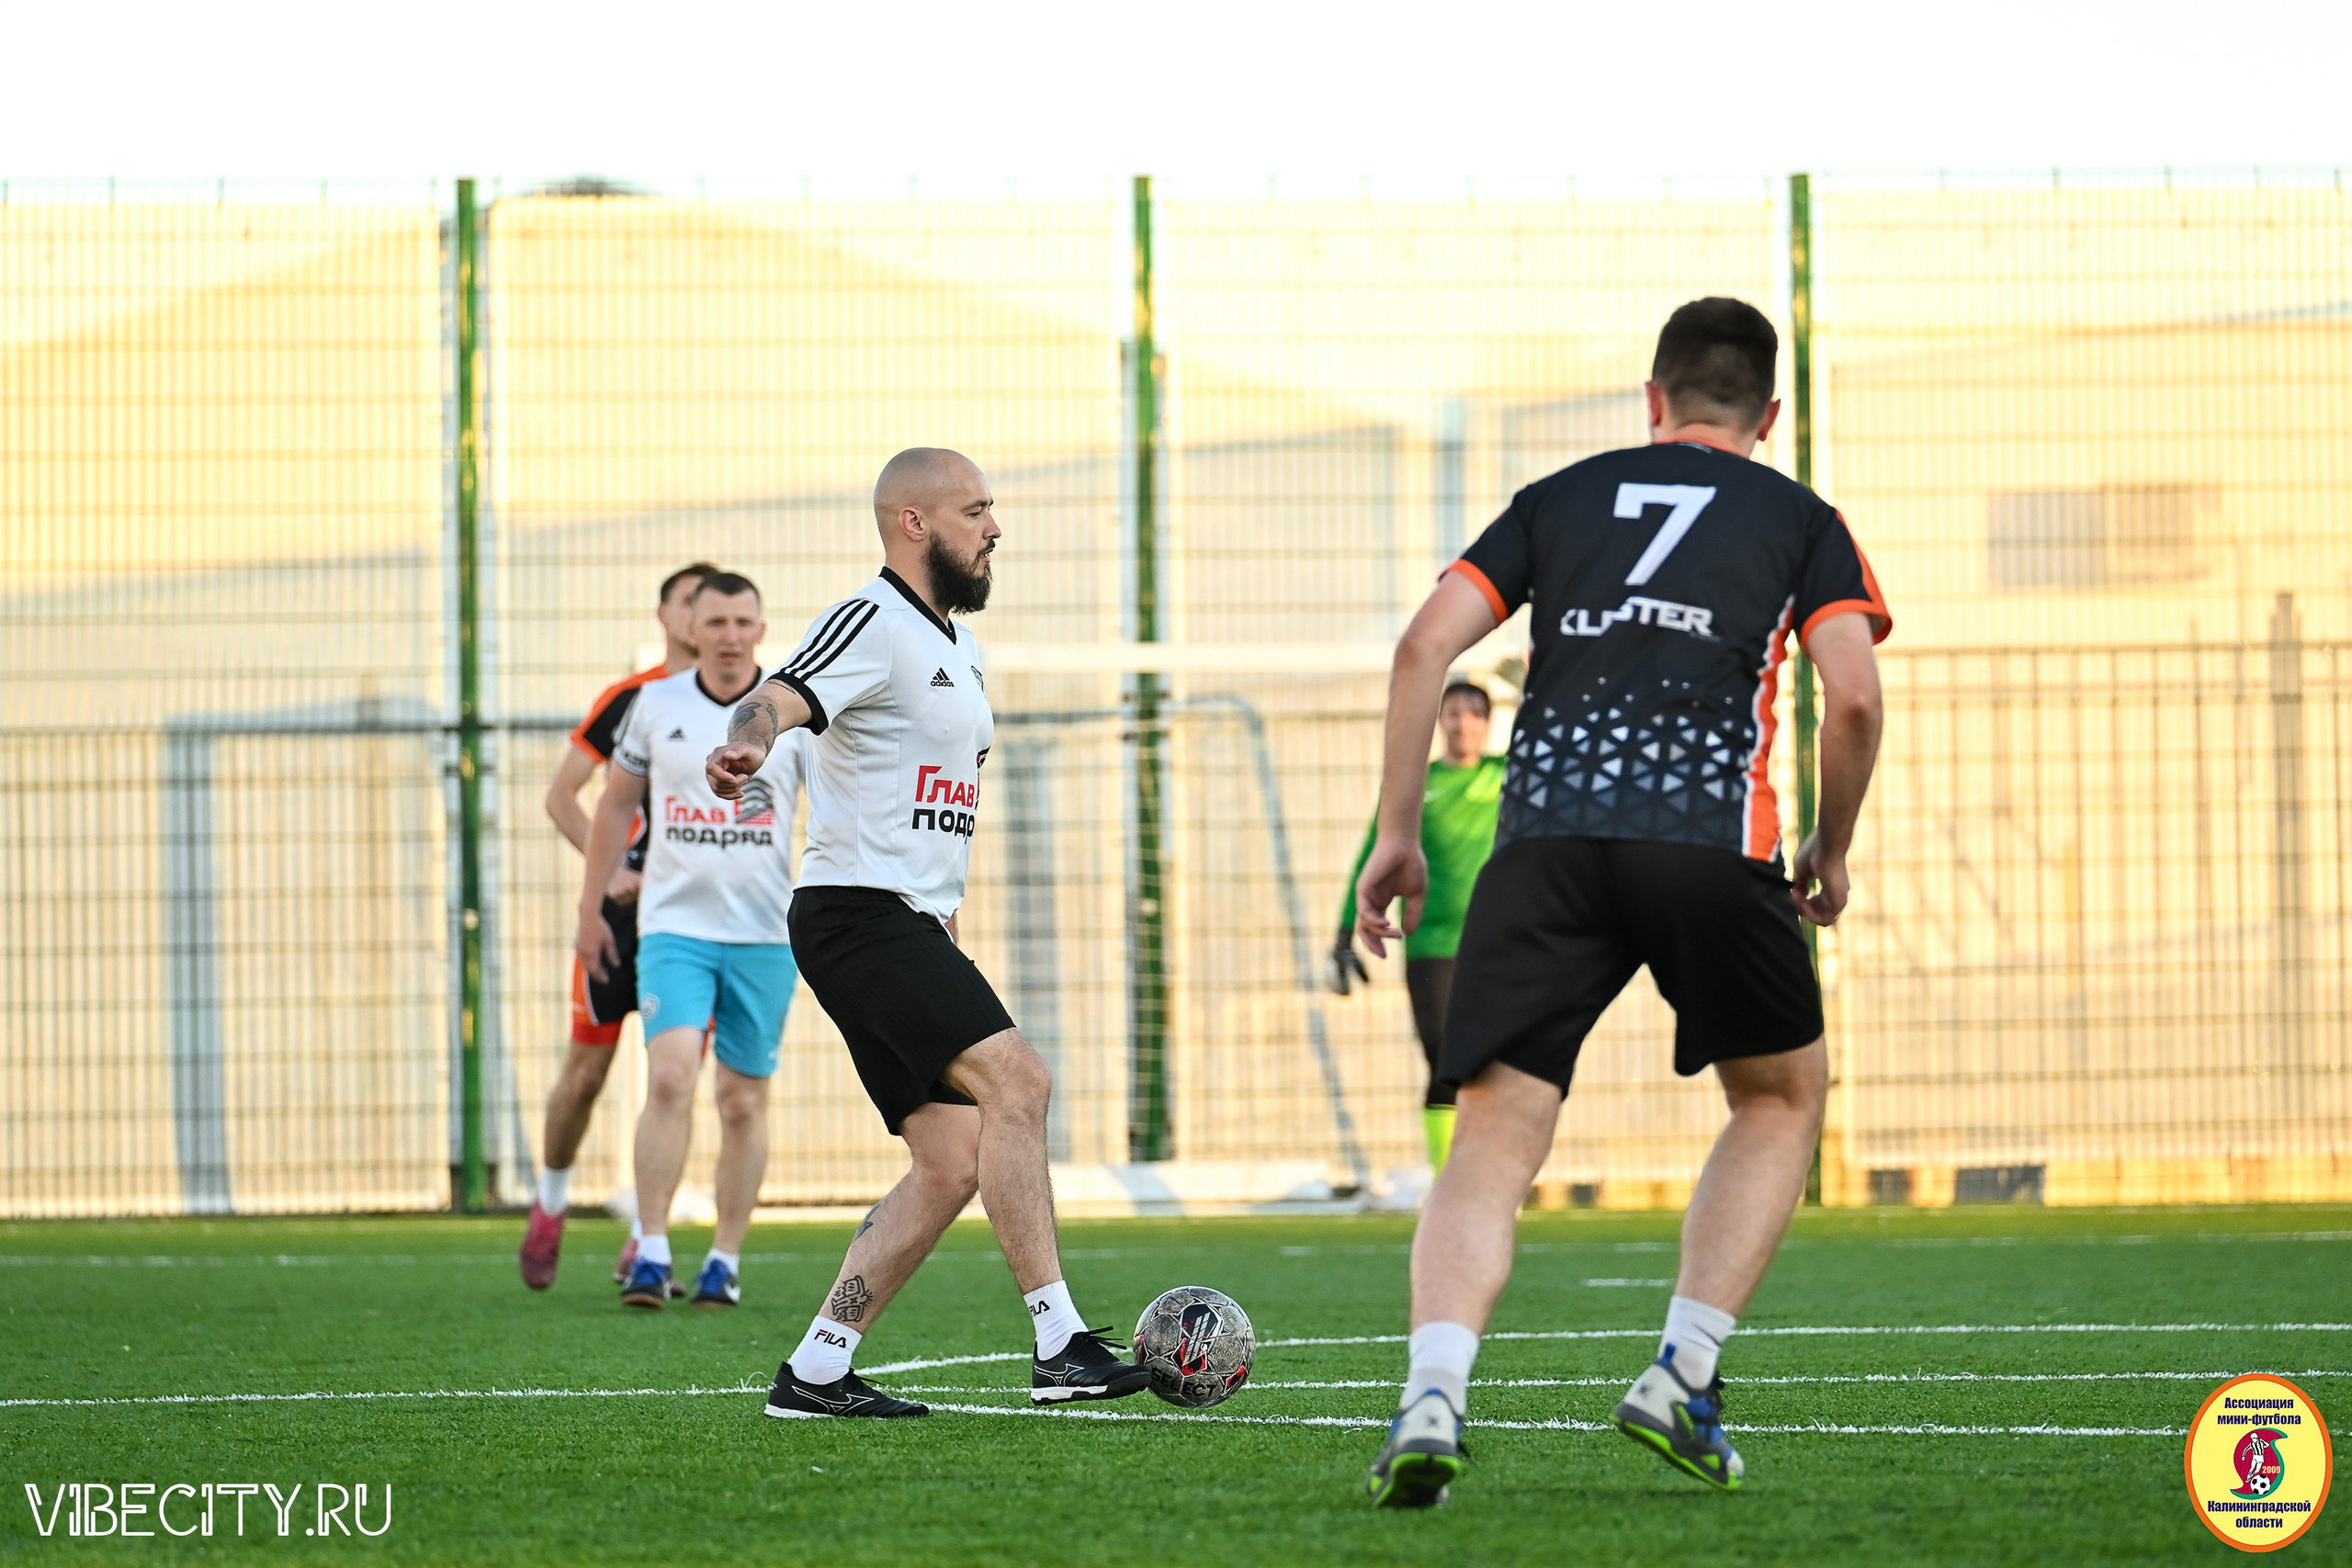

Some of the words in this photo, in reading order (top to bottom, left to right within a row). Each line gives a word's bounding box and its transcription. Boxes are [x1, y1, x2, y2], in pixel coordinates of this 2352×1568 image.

[1613, 482, 1717, 586] 7
[911, 808, 975, 844] подр
[814, 1329, 846, 1348] FILA
